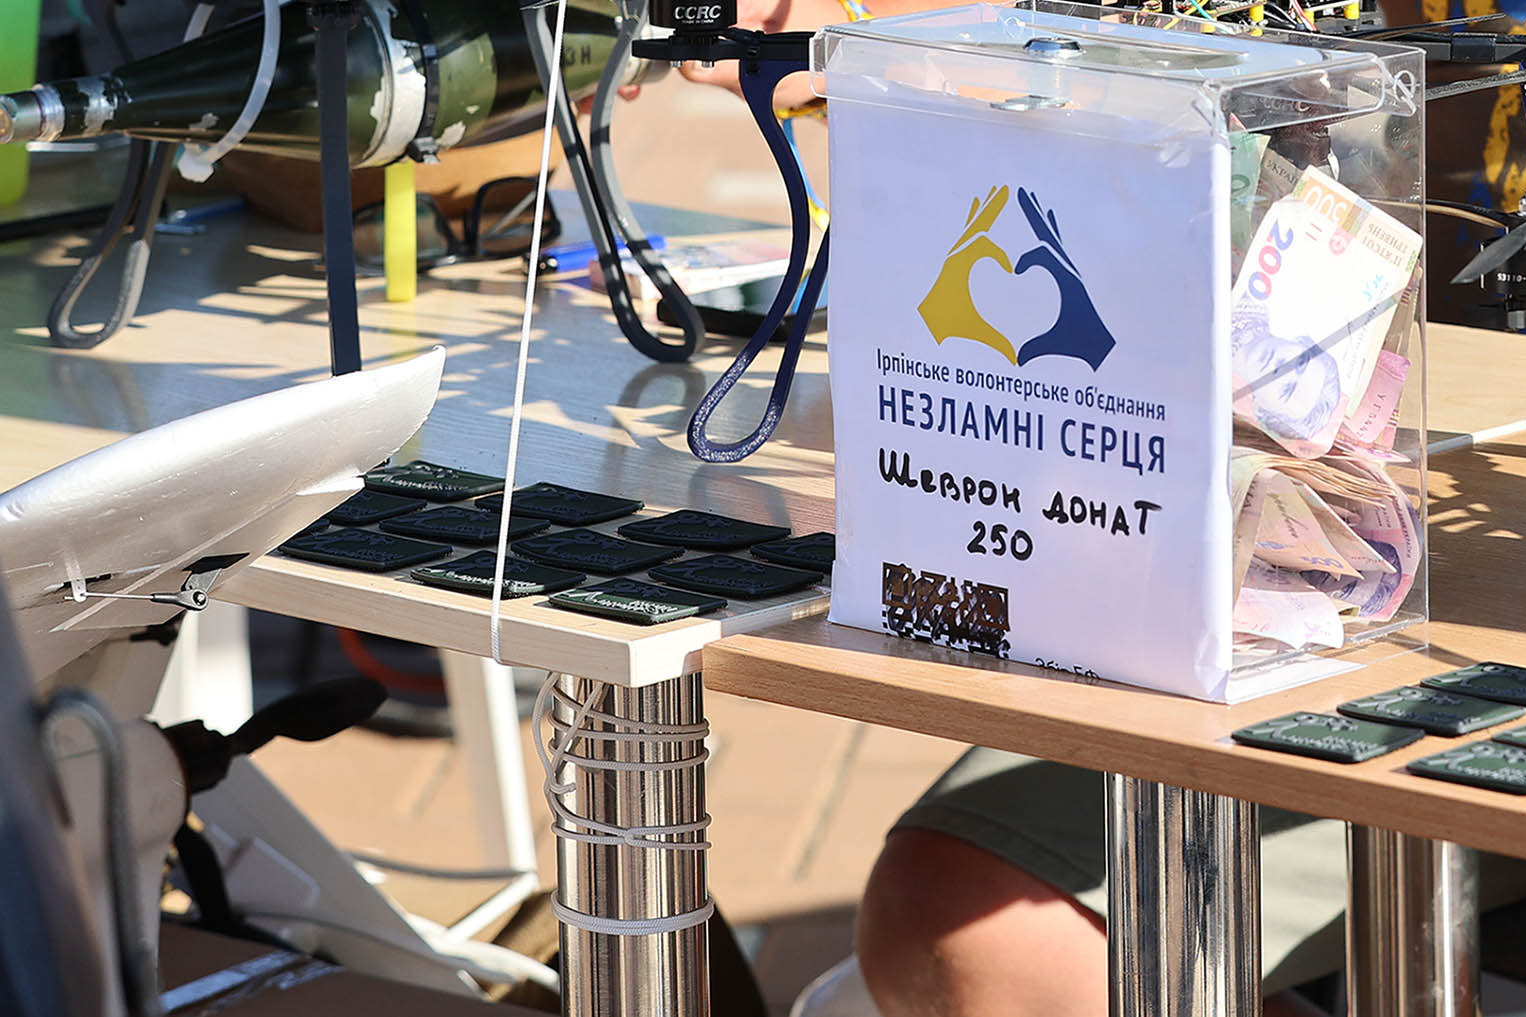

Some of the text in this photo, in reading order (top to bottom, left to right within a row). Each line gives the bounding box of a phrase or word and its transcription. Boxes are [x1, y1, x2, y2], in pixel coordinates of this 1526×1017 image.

[674, 5, 722, 20] CCRC
[1248, 219, 1294, 301] 200
[876, 348, 1166, 421] Ірпінське волонтерське об'єднання
[878, 384, 1166, 476] НЕЗЛАМНІ СЕРЦЯ
[966, 521, 1034, 561] 250
